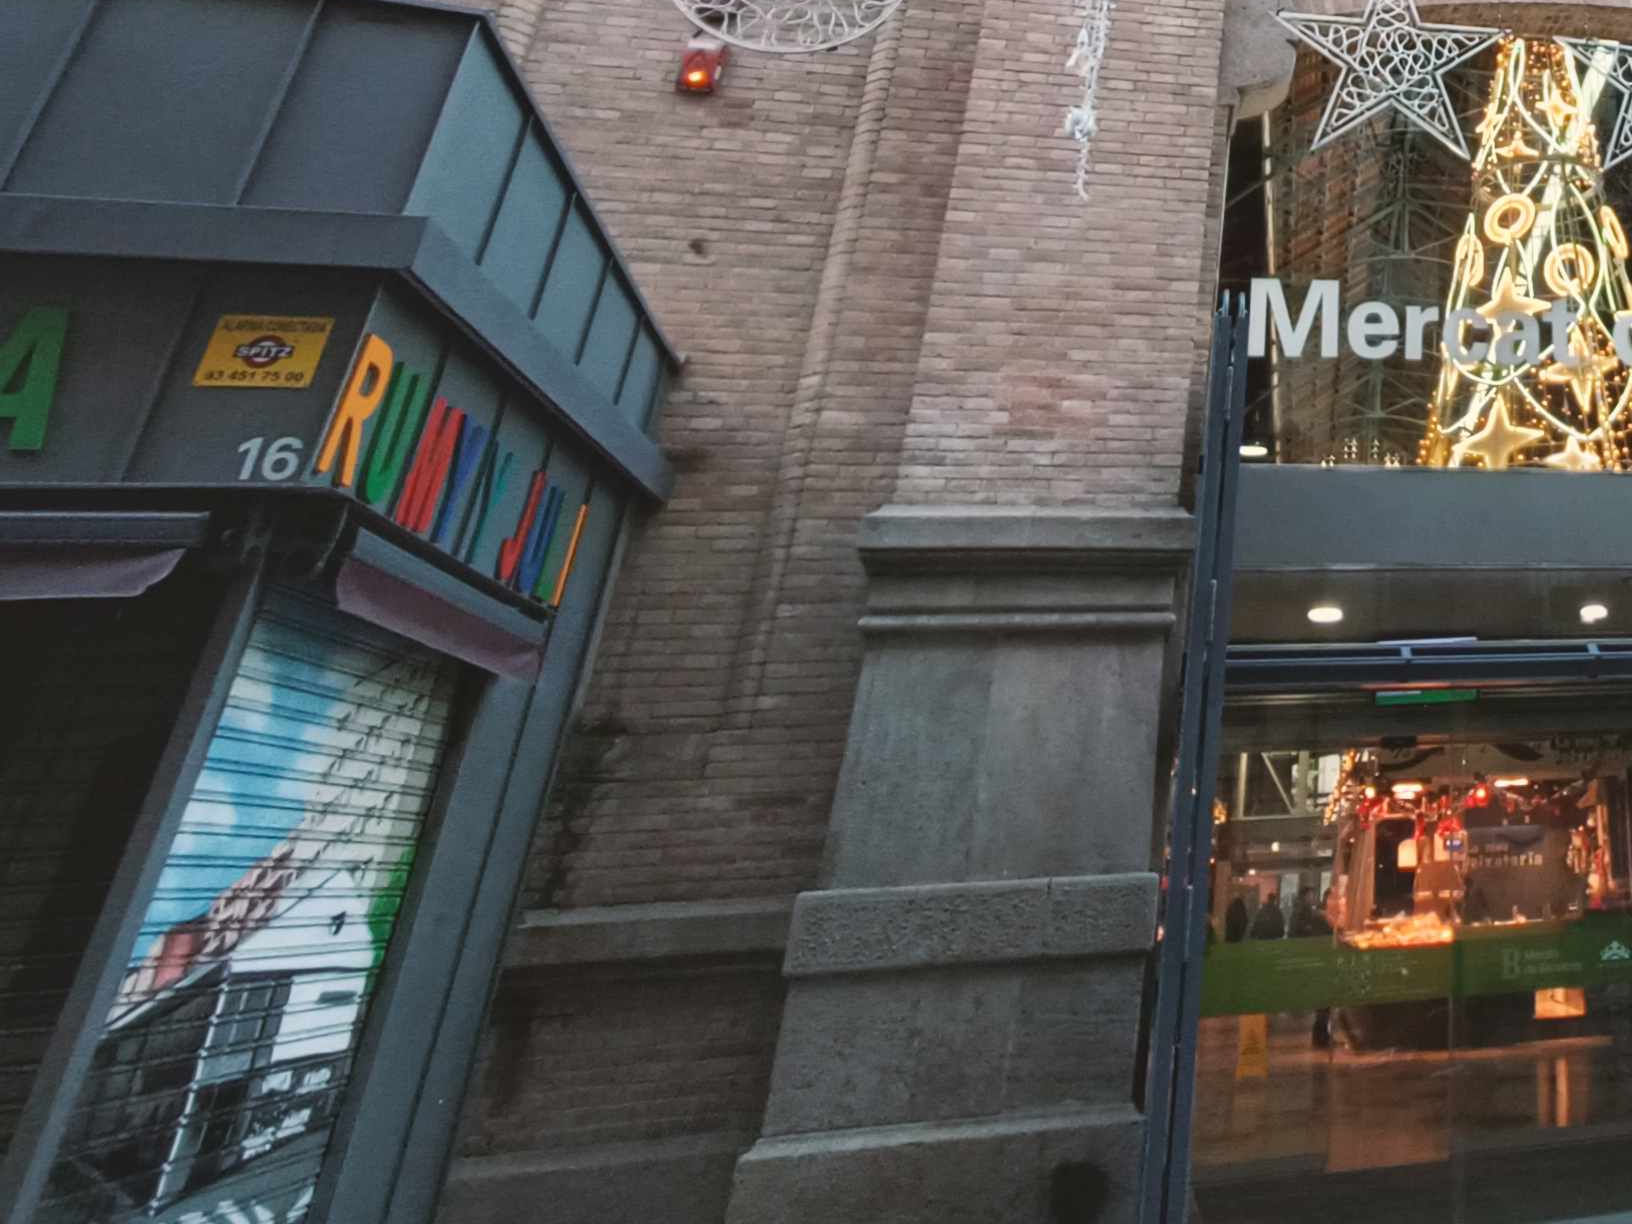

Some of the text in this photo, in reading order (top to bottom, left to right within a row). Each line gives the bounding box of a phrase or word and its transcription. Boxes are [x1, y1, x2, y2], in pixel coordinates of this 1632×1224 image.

[1247, 277, 1581, 367] Mercat
[235, 345, 293, 358] SPITZ
[238, 436, 304, 481] 16
